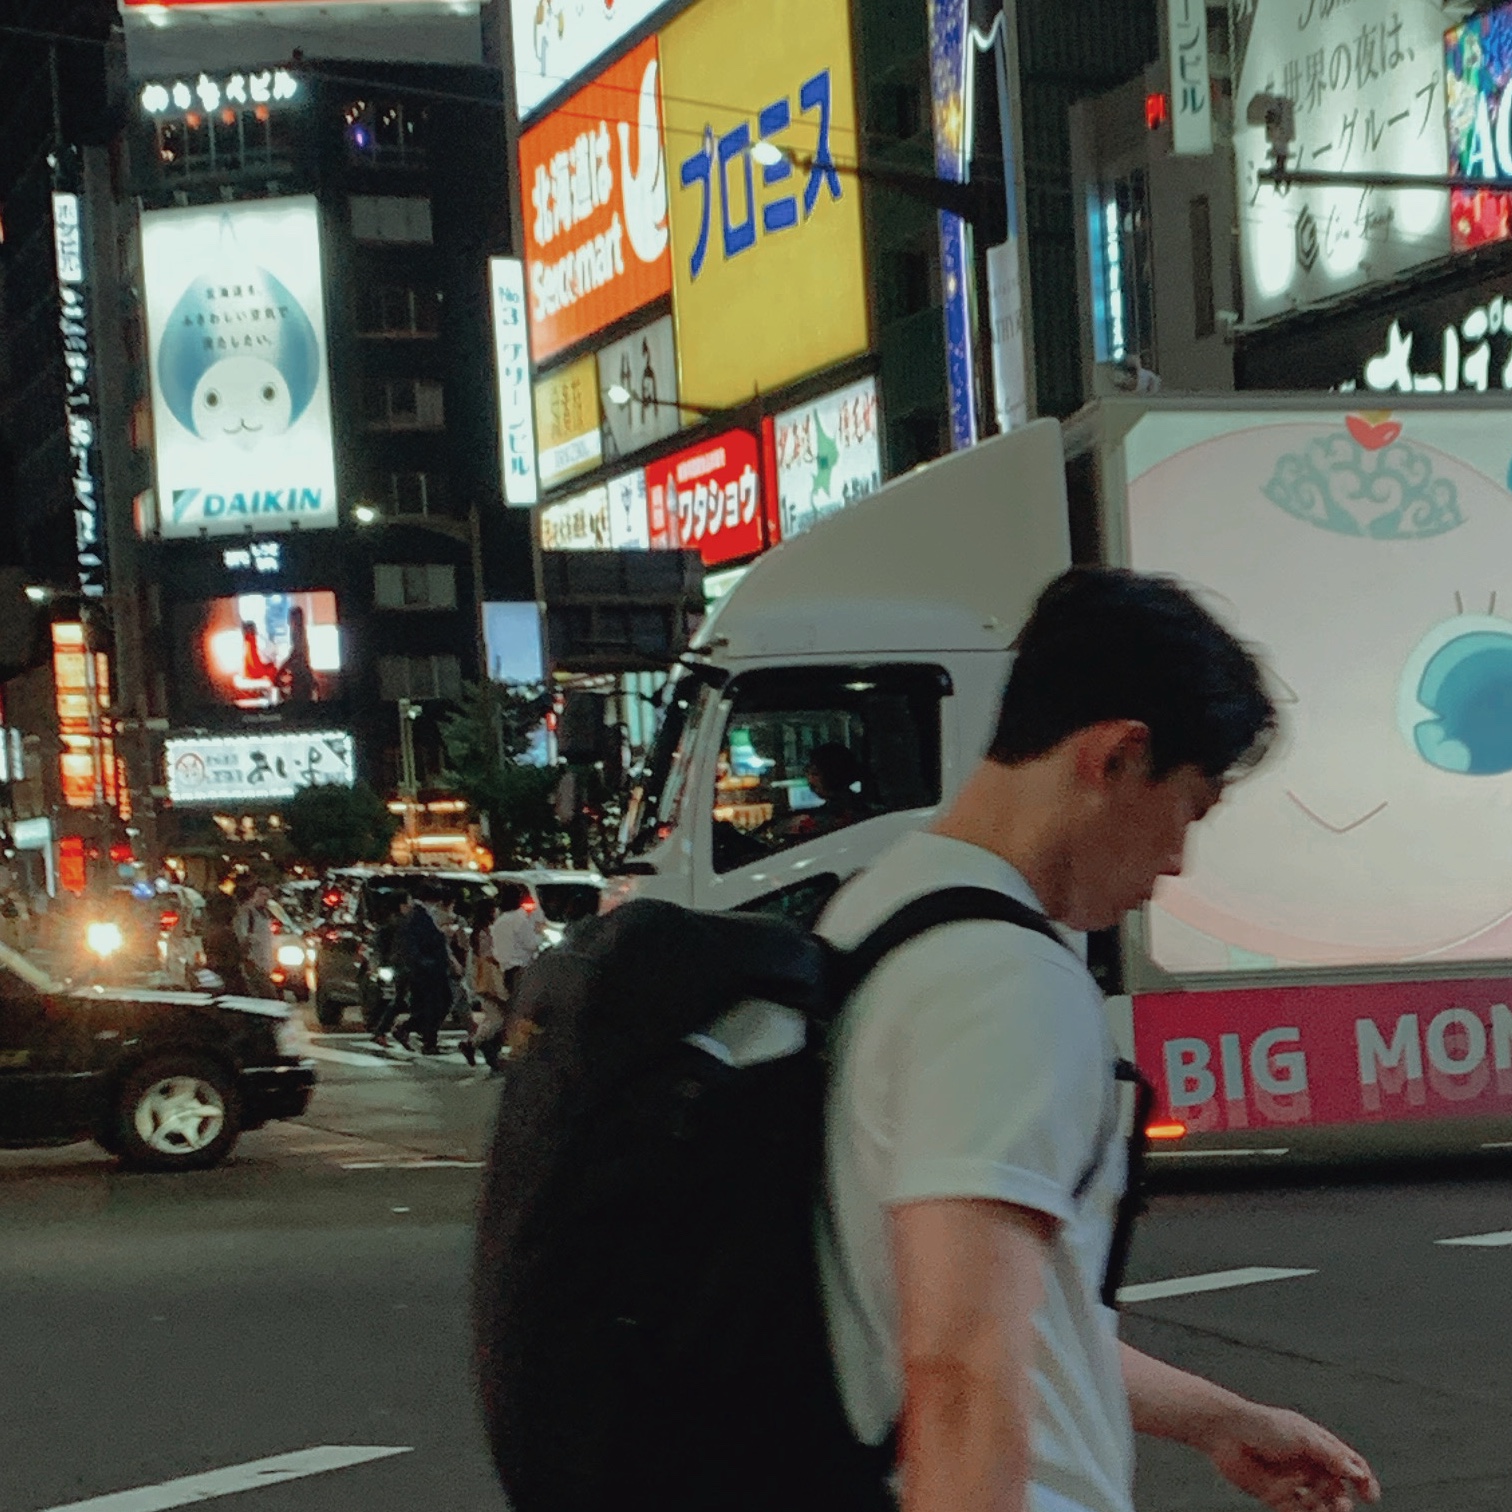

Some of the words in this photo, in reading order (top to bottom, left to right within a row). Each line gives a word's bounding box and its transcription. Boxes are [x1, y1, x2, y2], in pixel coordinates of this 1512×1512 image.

[680, 67, 842, 282] プロミス
[203, 488, 322, 517] DAIKIN
[1163, 1026, 1310, 1109] BIG
